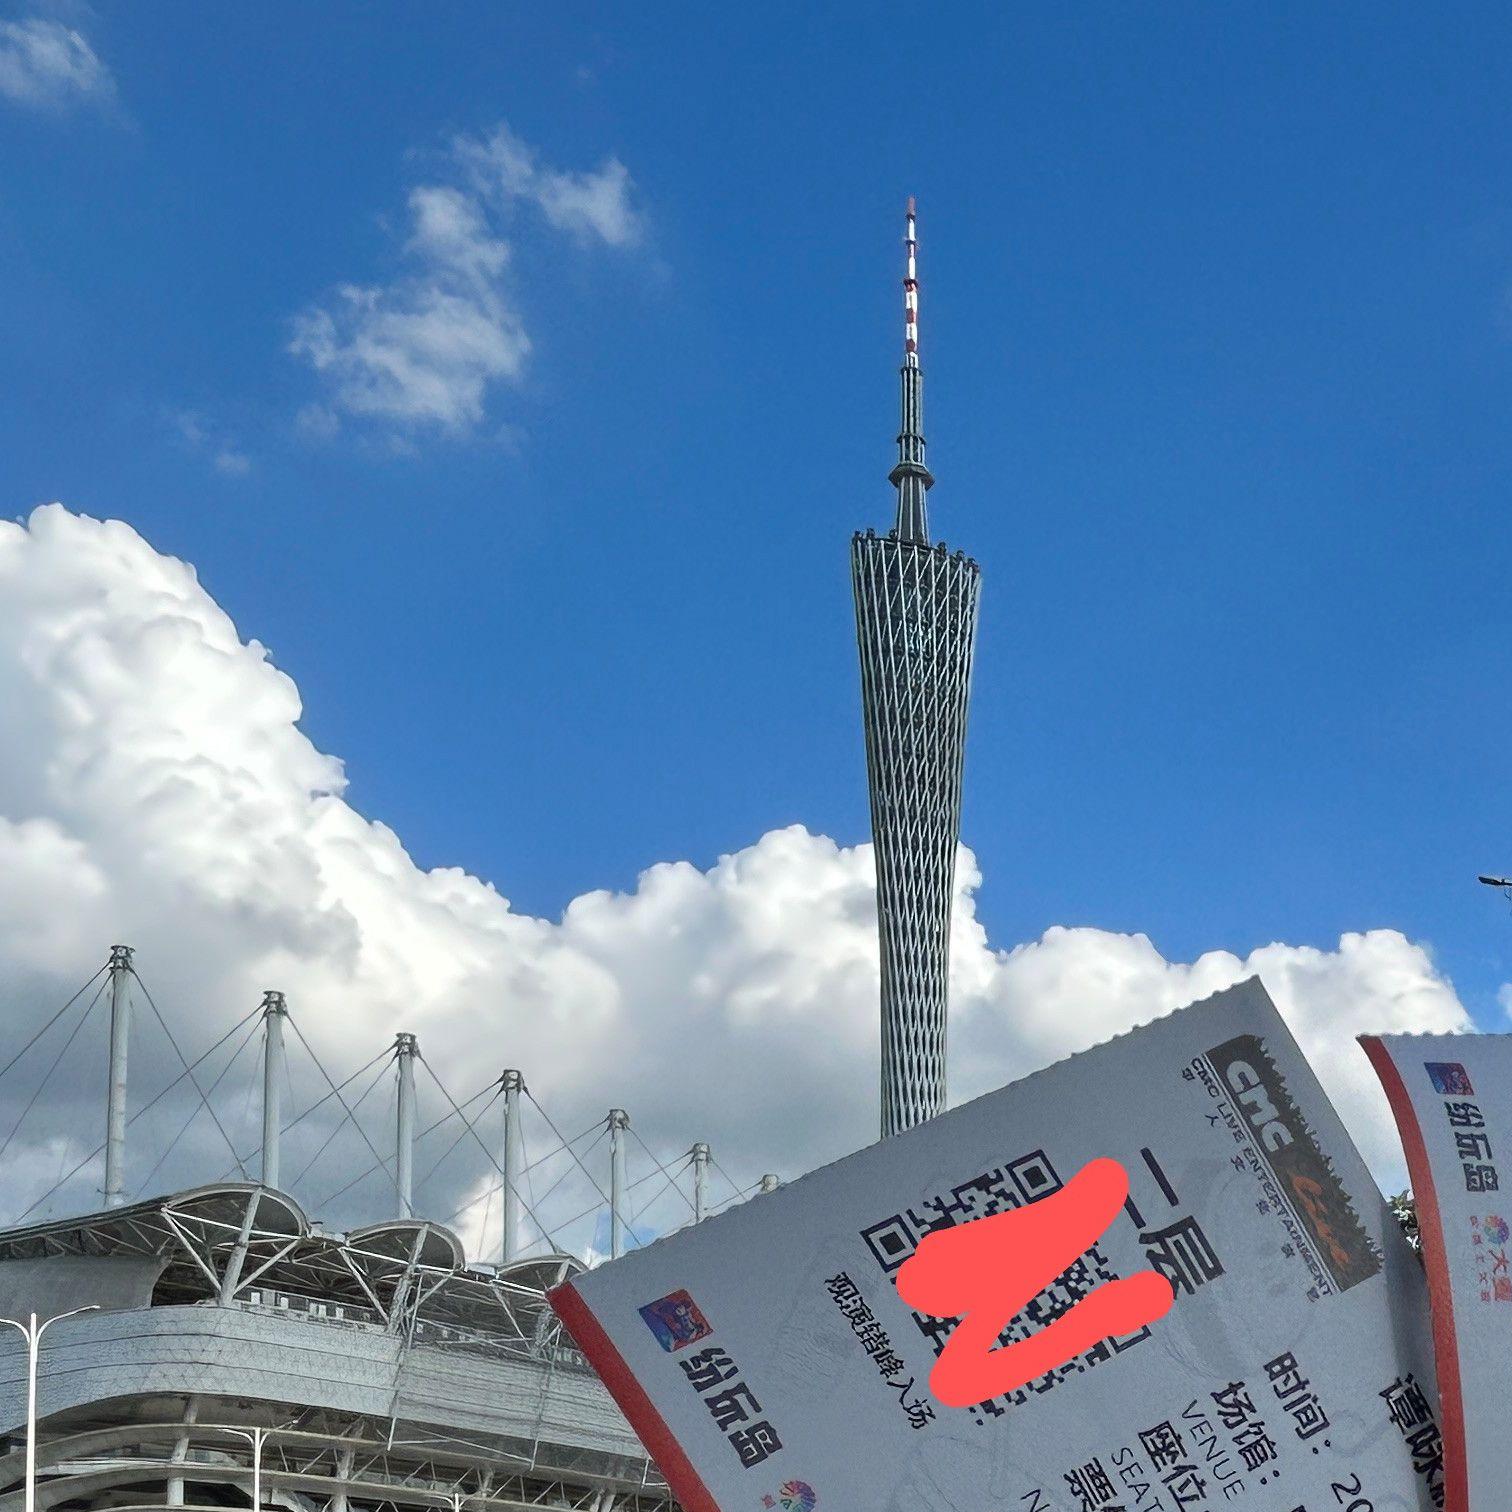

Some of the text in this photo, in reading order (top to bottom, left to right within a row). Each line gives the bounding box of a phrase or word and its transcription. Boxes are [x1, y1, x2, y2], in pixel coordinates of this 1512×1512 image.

[1221, 1054, 1295, 1154] CMC
[1443, 1102, 1498, 1192] 纷玩岛
[1118, 1145, 1227, 1300] 二层
[677, 1342, 785, 1470] 纷玩岛
[1177, 1398, 1246, 1502] VENUE
[1205, 1376, 1290, 1490] 场馆：
[1259, 1349, 1342, 1460] 时间：
